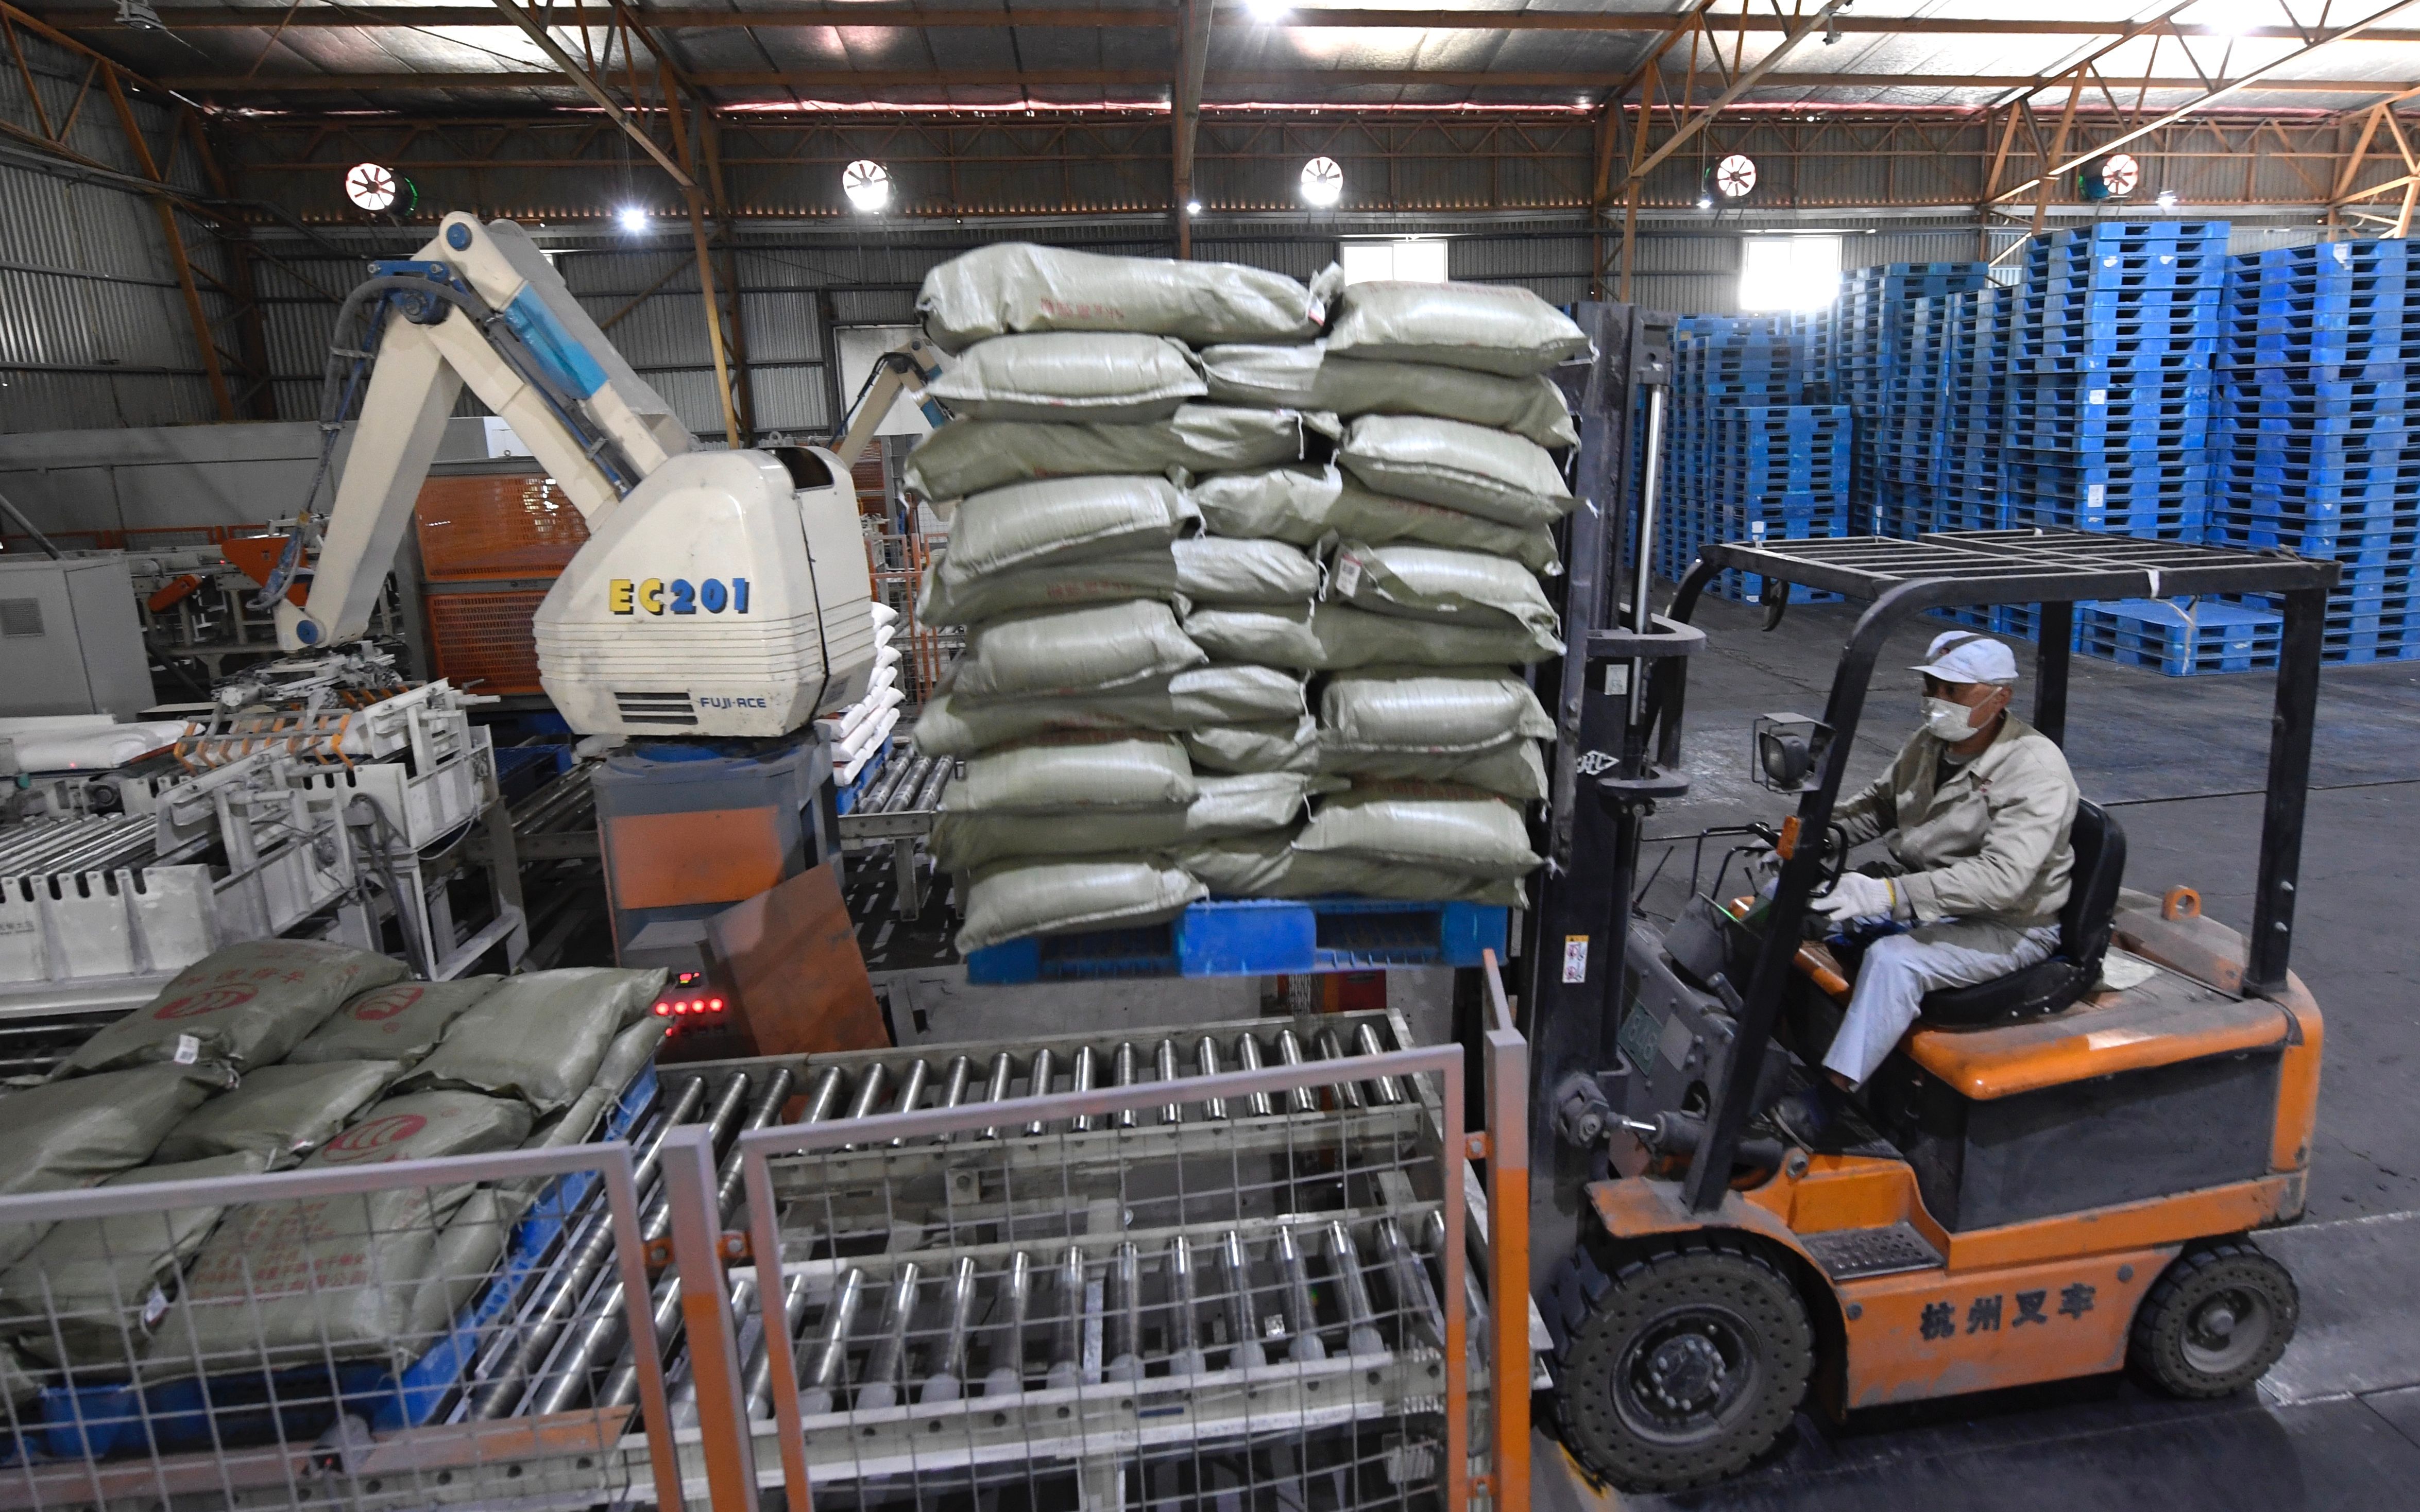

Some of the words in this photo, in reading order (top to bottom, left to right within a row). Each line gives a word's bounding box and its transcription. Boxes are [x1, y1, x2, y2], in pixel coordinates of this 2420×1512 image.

[610, 578, 749, 615] EC201
[701, 697, 766, 709] FUJI-ACE
[1920, 1282, 2096, 1341] 杭州叉车
